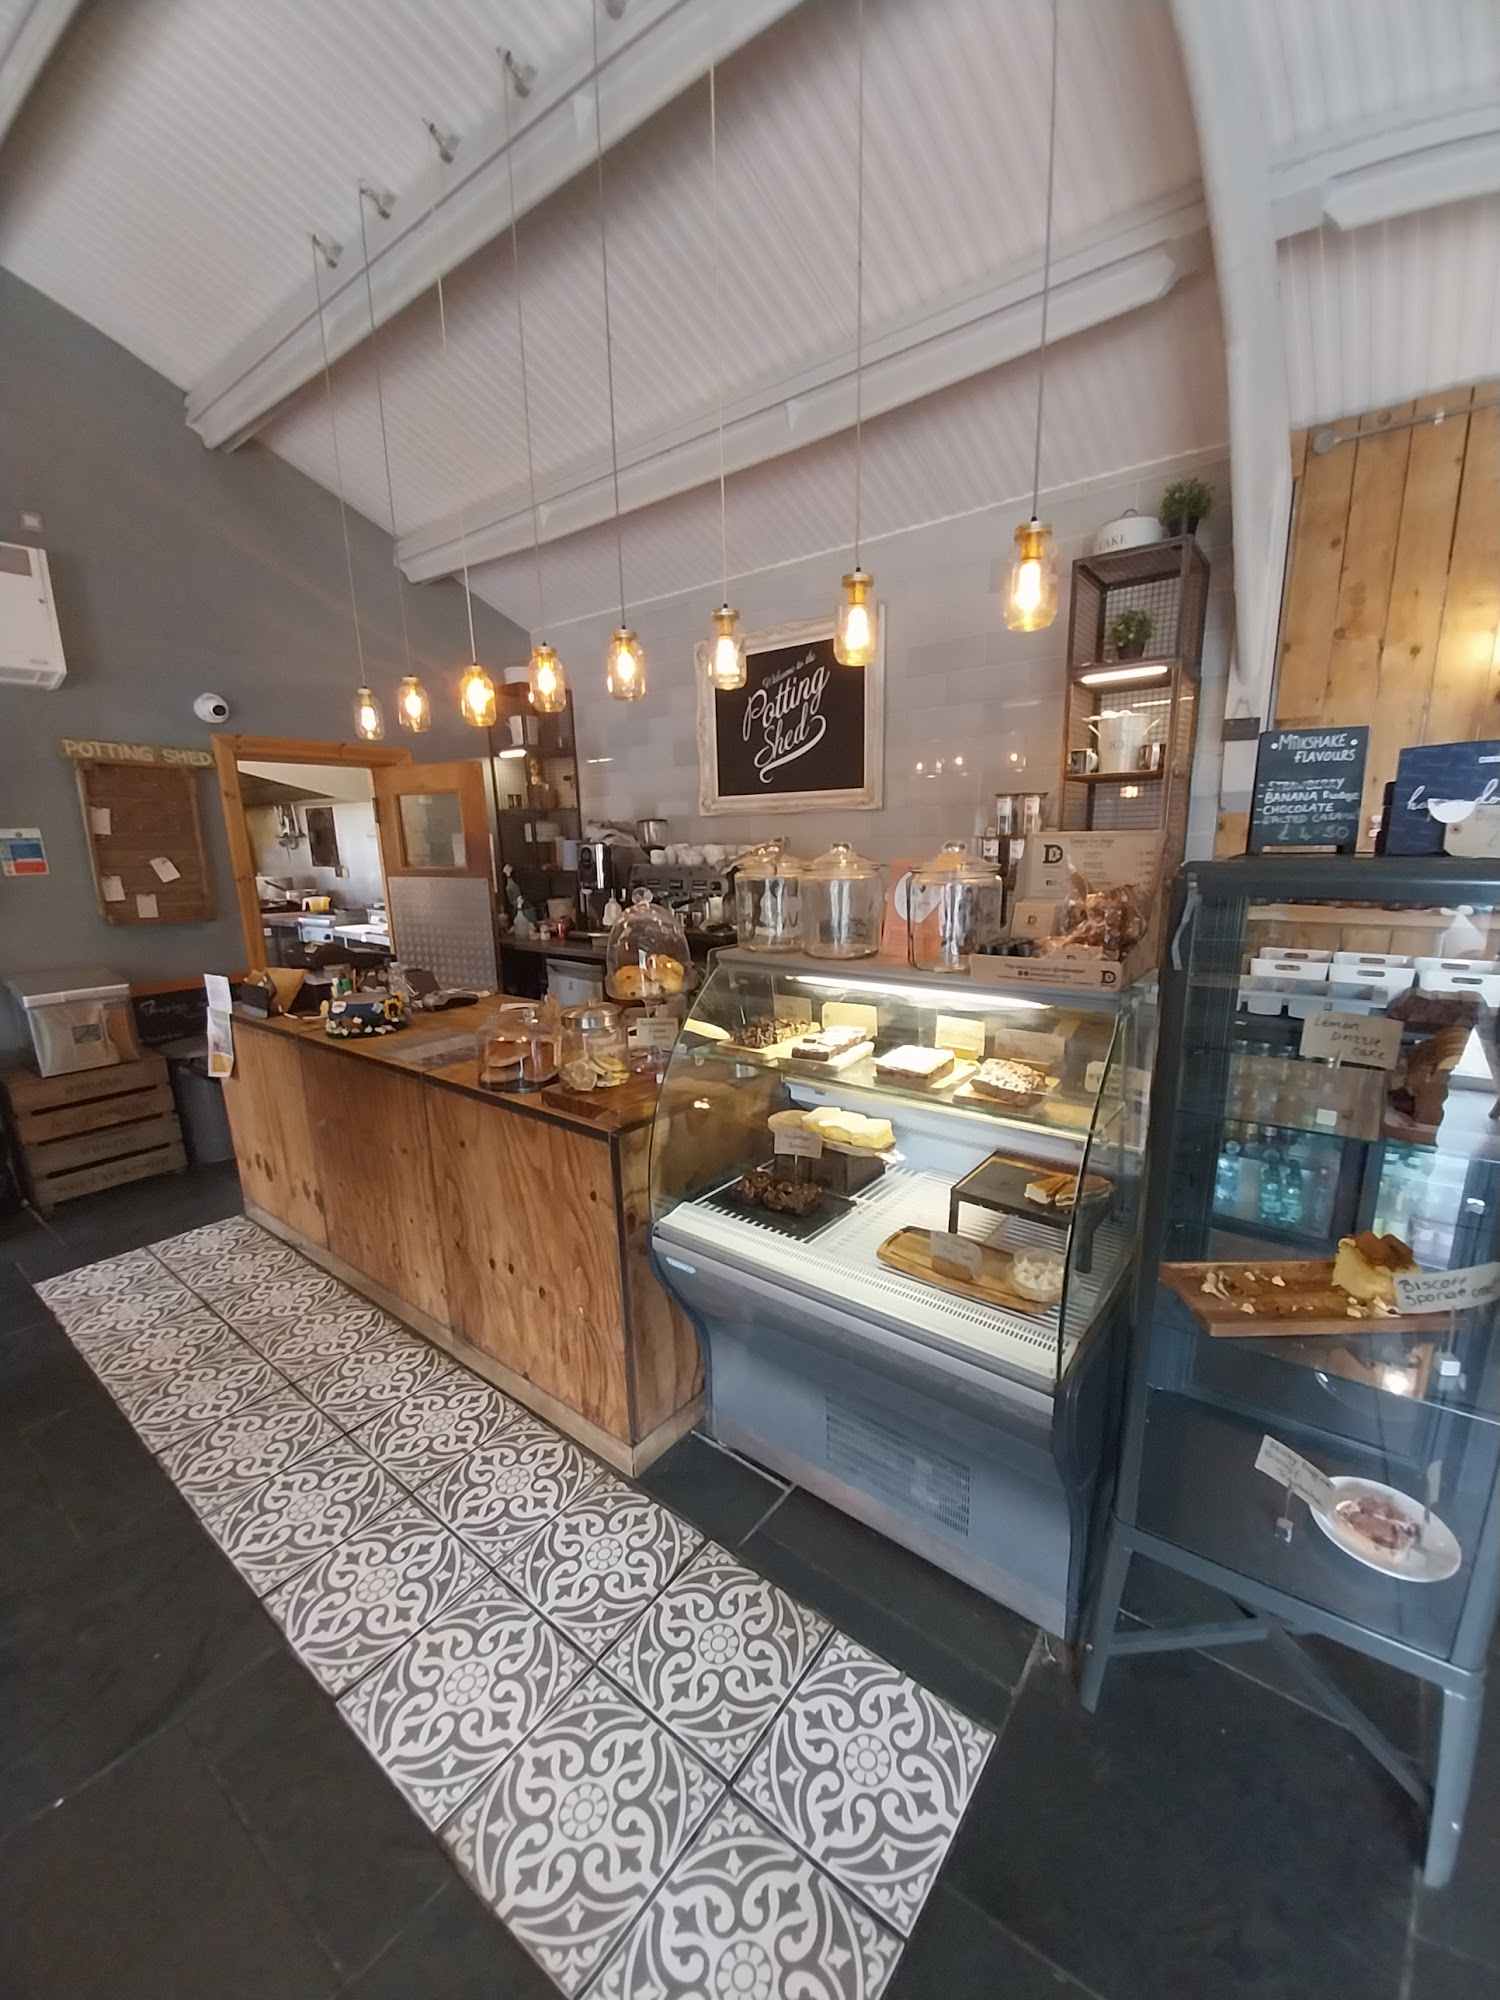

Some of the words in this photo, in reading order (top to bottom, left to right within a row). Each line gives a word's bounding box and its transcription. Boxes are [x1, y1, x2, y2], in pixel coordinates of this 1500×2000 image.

[742, 666, 831, 741] Potting
[754, 702, 822, 775] Shed
[61, 739, 155, 762] POTTING
[162, 748, 213, 766] SHED
[1294, 749, 1357, 763] FLAVOURS
[1264, 791, 1319, 804] BANANA
[1263, 803, 1334, 814] CHOCOLATE
[1313, 1015, 1360, 1030] Lemon
